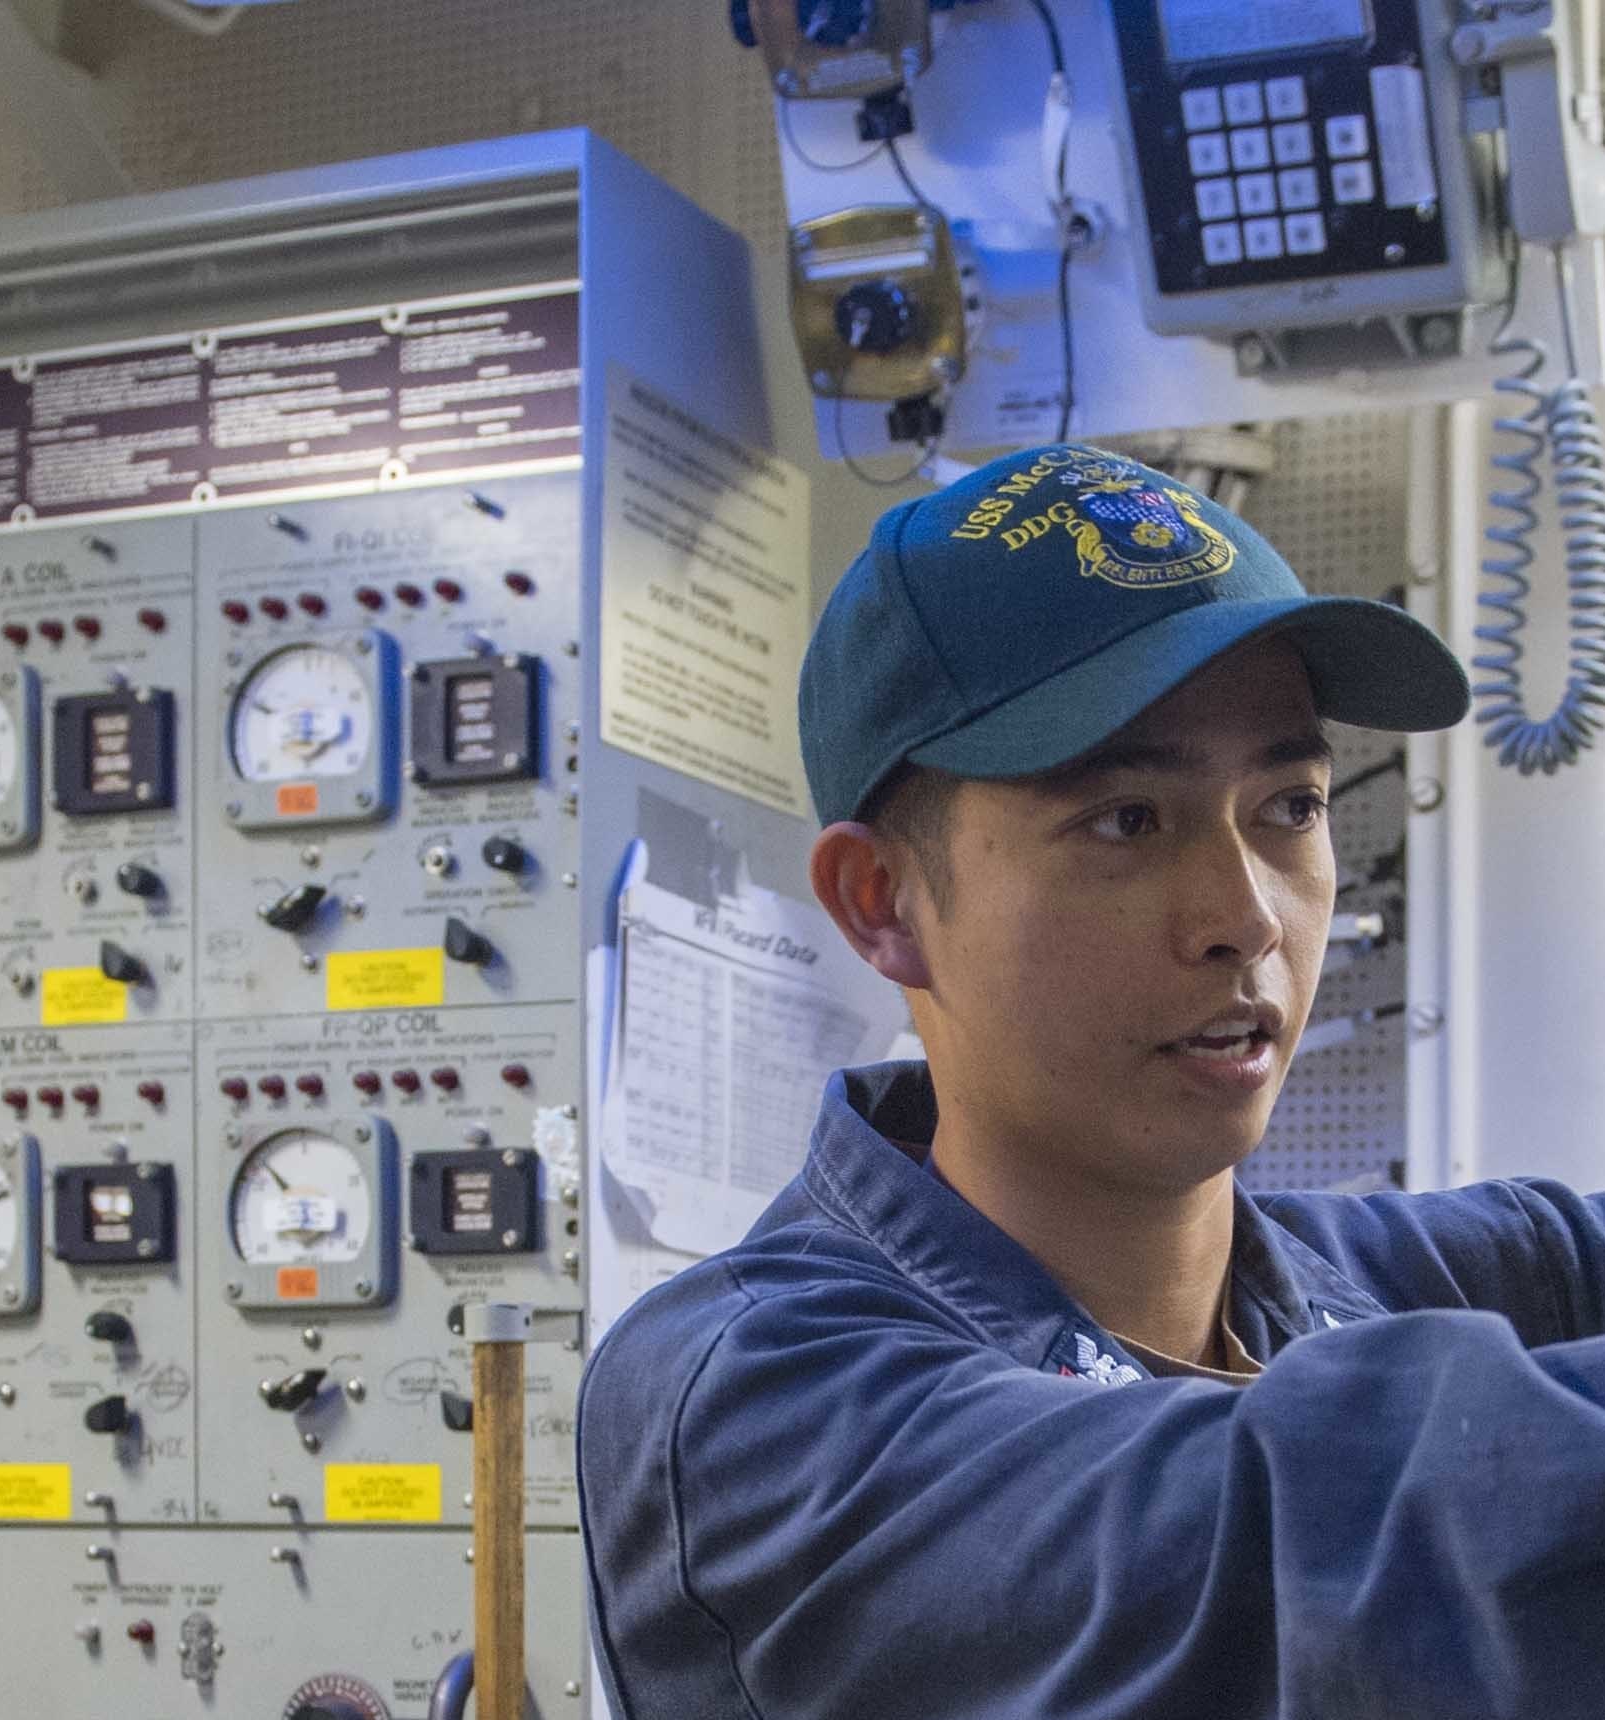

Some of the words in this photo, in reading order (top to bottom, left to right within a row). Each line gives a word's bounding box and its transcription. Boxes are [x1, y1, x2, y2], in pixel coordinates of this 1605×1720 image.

[949, 497, 1014, 539] USS
[1000, 502, 1076, 551] DDG
[1, 567, 13, 585] A
[22, 562, 68, 584] COIL
[1097, 559, 1193, 583] RELENTLESS
[773, 936, 819, 966] Data
[394, 1013, 443, 1034] COIL
[0, 1036, 17, 1054] M
[22, 1033, 65, 1052] COIL
